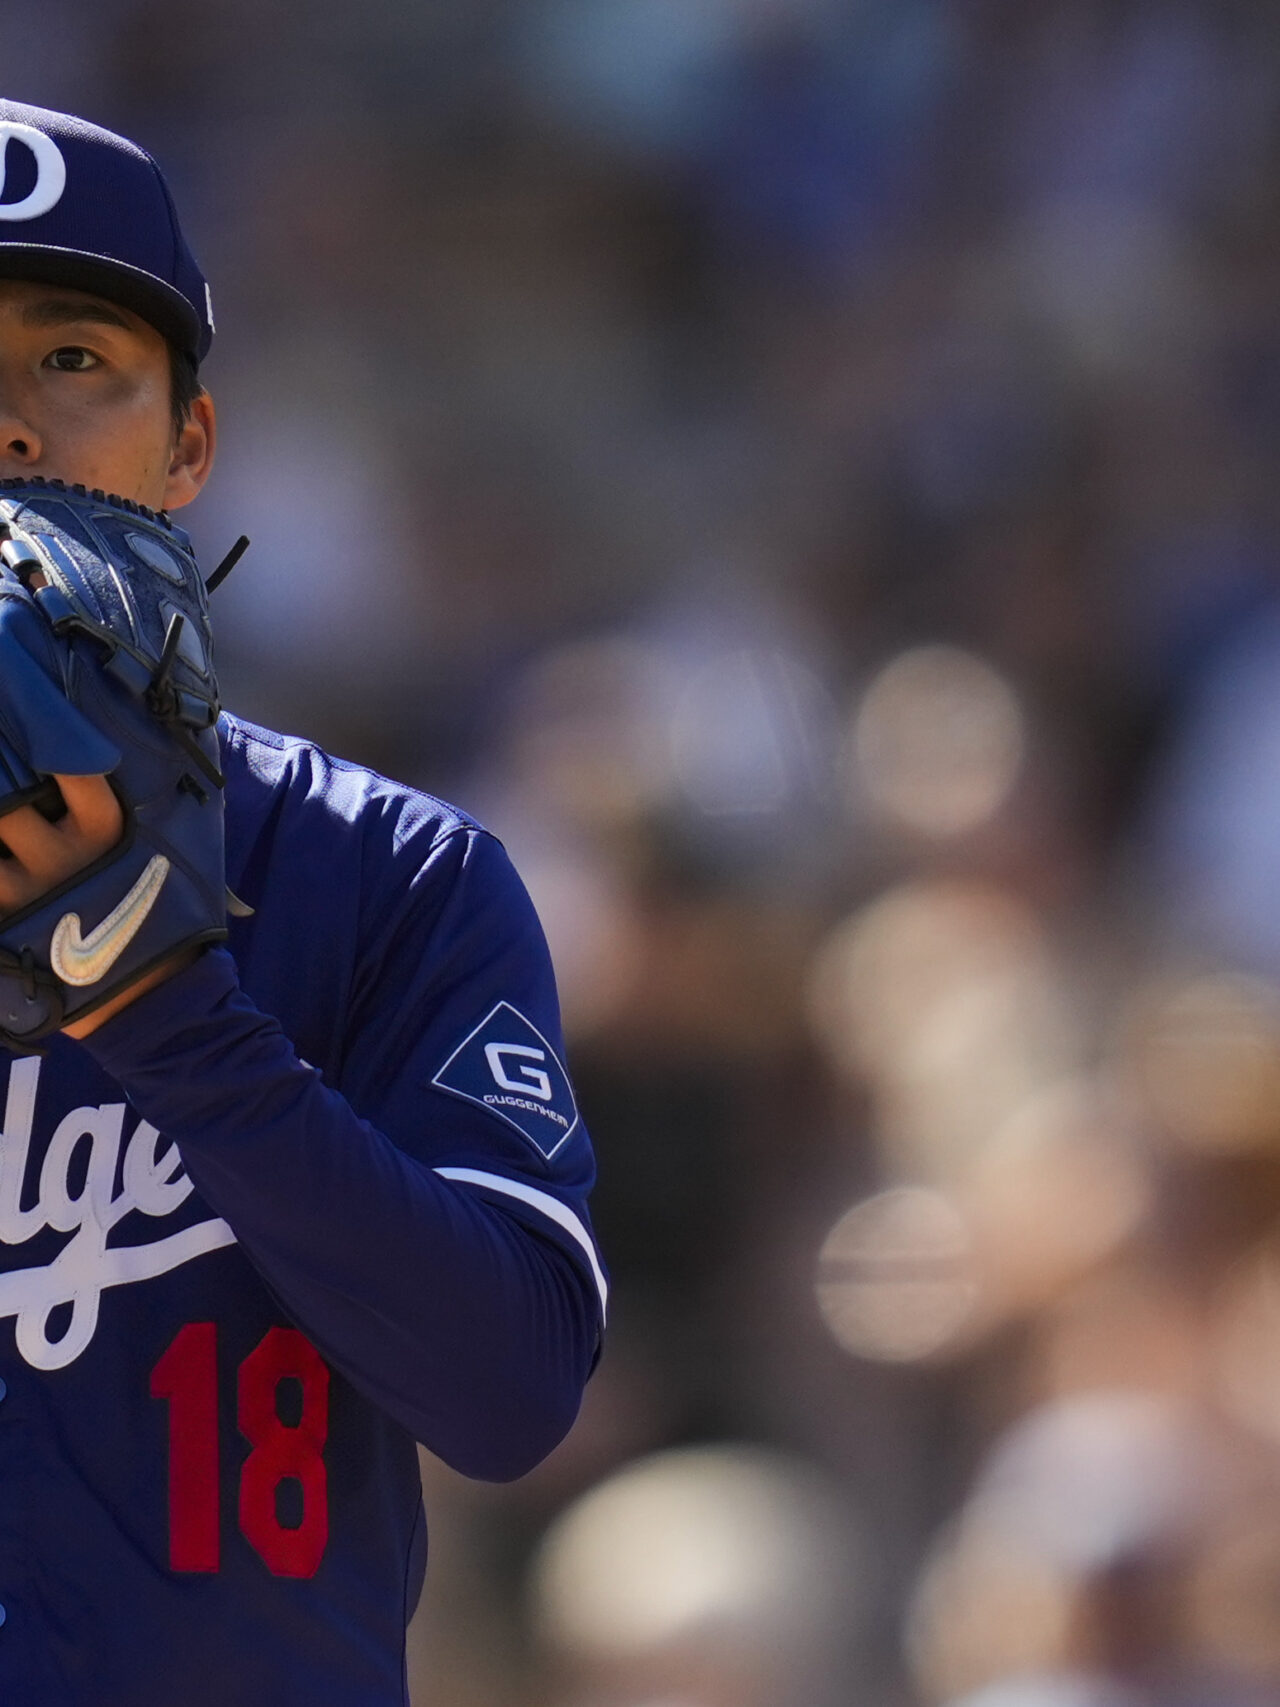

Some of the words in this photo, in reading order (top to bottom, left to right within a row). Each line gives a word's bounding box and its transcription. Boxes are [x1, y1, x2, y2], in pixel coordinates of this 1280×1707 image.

[484, 1042, 552, 1101] G
[483, 1094, 569, 1129] GUGGENHEIM
[149, 1321, 331, 1580] 18
